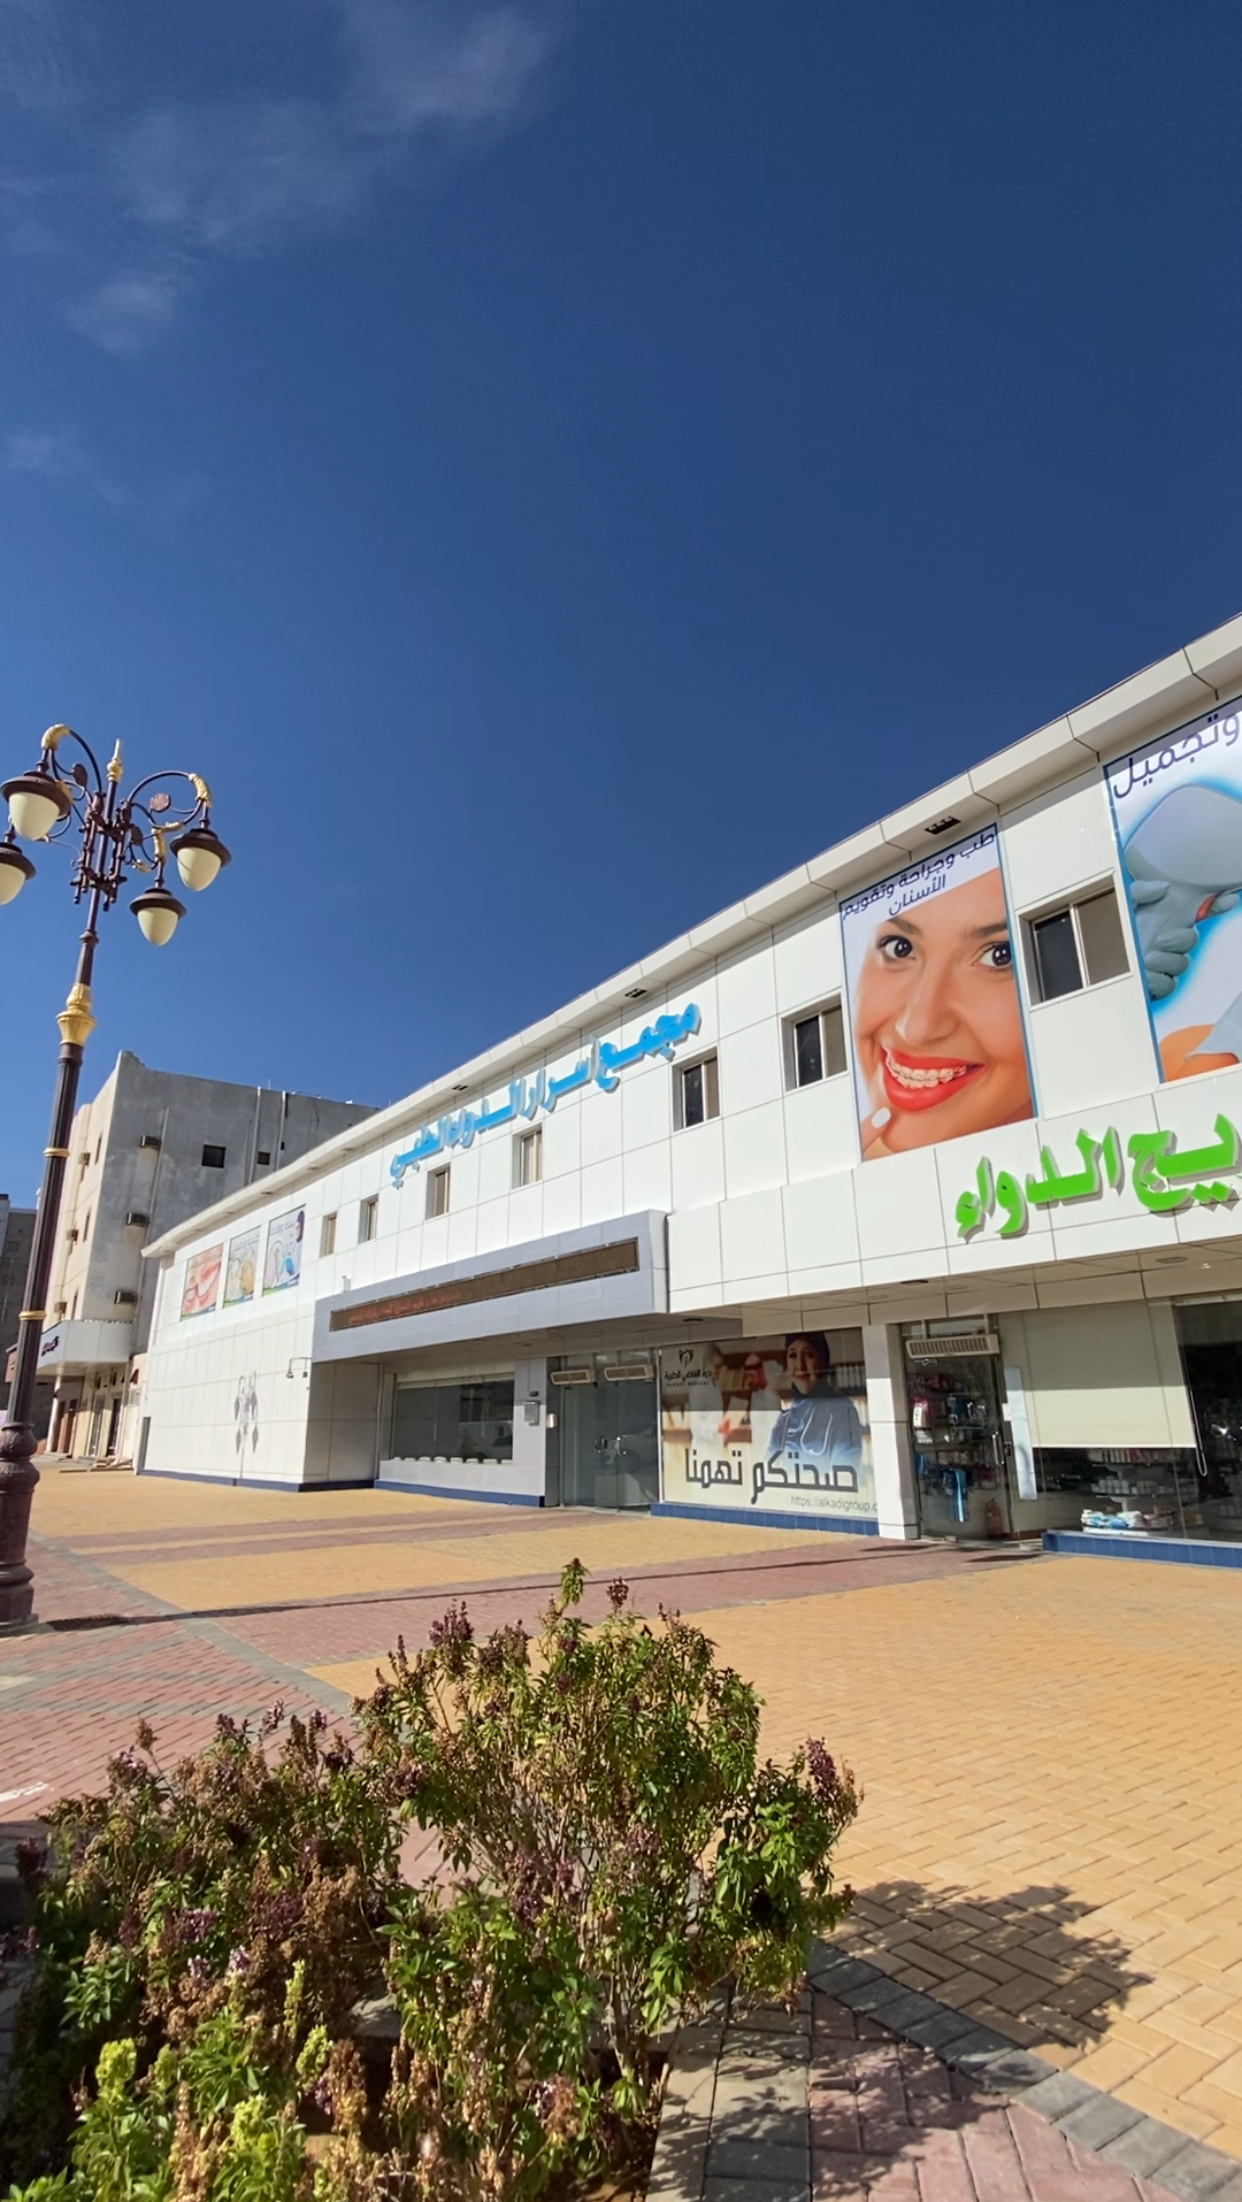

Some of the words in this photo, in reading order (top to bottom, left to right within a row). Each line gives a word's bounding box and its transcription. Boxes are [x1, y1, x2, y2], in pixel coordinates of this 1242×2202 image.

[1113, 713, 1240, 799] وتجميل
[959, 832, 995, 859] طب
[898, 852, 955, 888] وجراحة
[842, 883, 896, 920] وتقويم
[888, 873, 946, 916] الأسنان
[594, 1002, 702, 1093] مجمع
[955, 1125, 1124, 1243] الدواء
[685, 1448, 743, 1489] تهمنا
[750, 1450, 859, 1505] صحتكم
